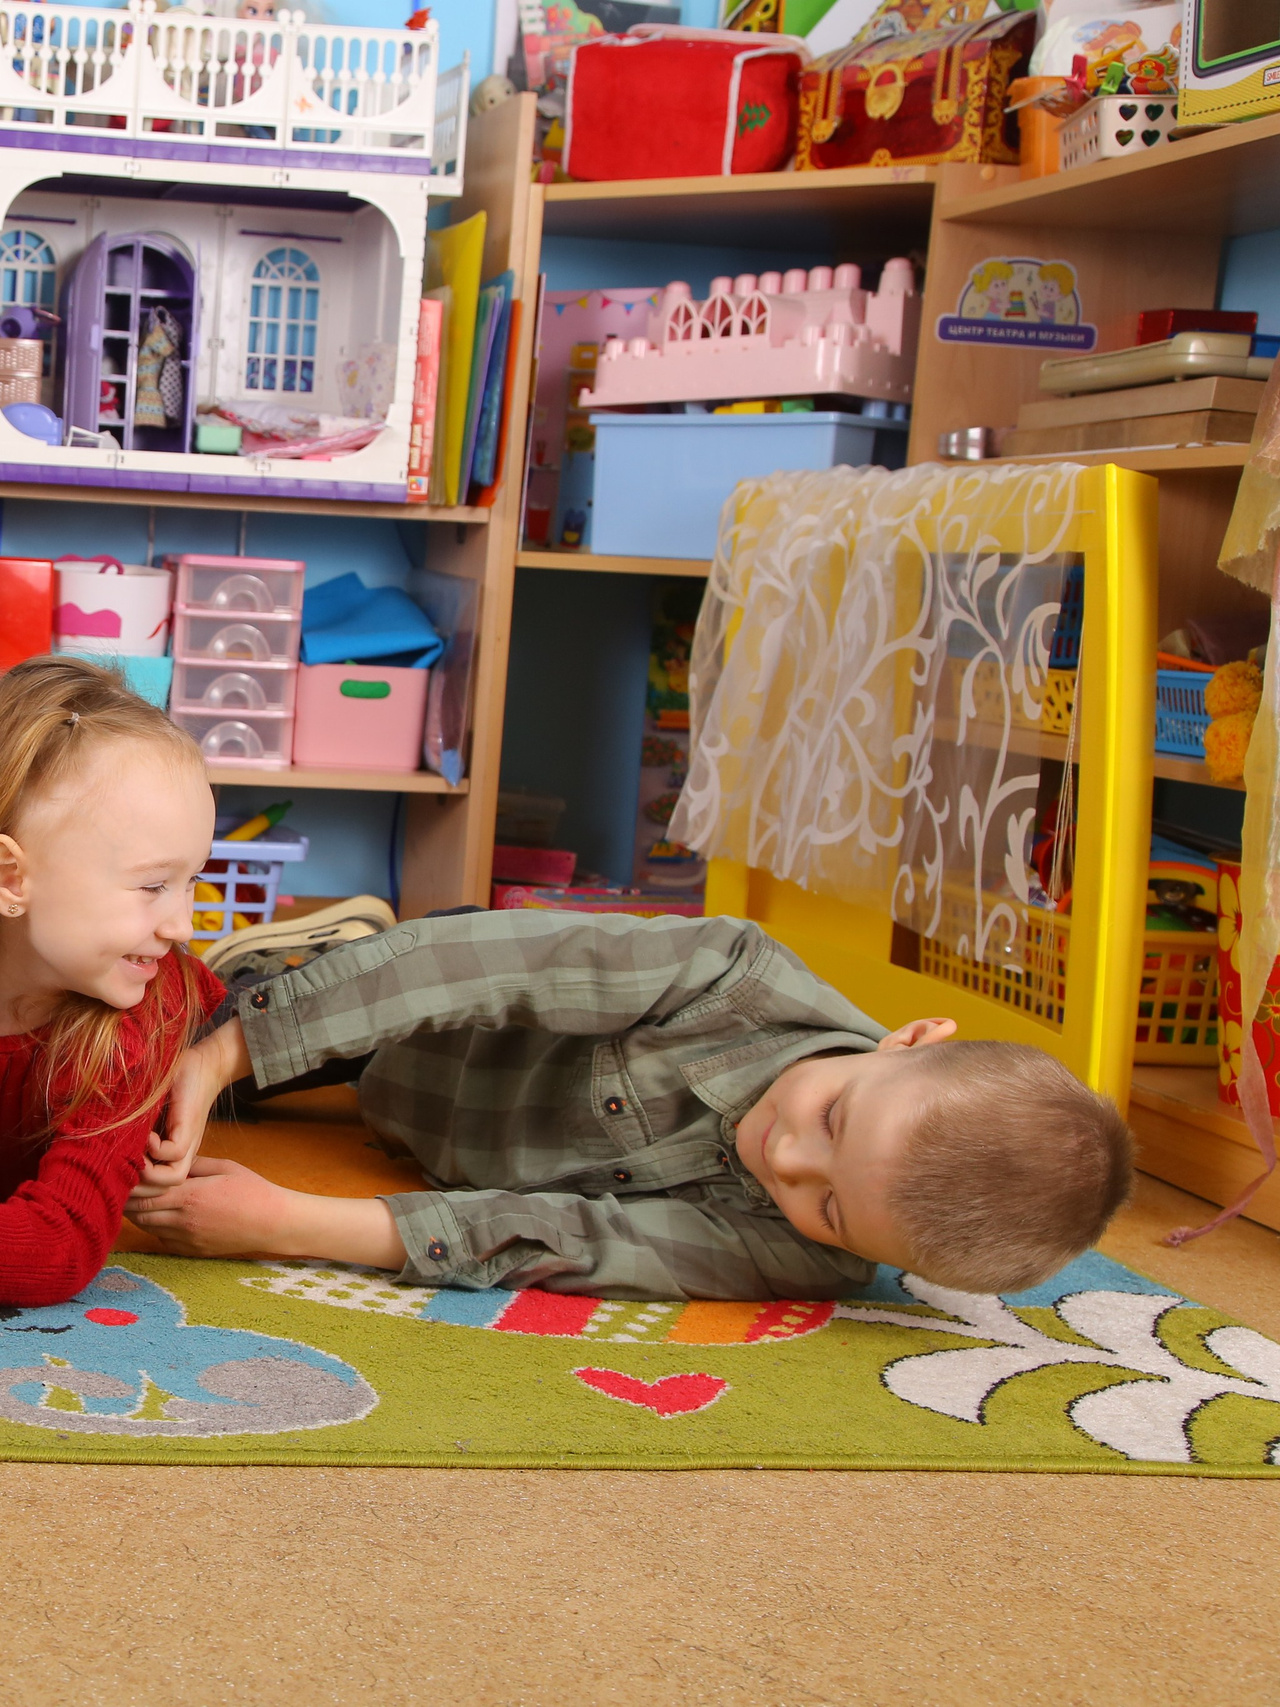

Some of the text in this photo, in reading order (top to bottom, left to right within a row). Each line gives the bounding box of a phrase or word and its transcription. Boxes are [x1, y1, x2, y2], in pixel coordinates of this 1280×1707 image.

[948, 325, 1085, 343] ЦЕНТР ТЕАТРА И МУЗЫКИ
